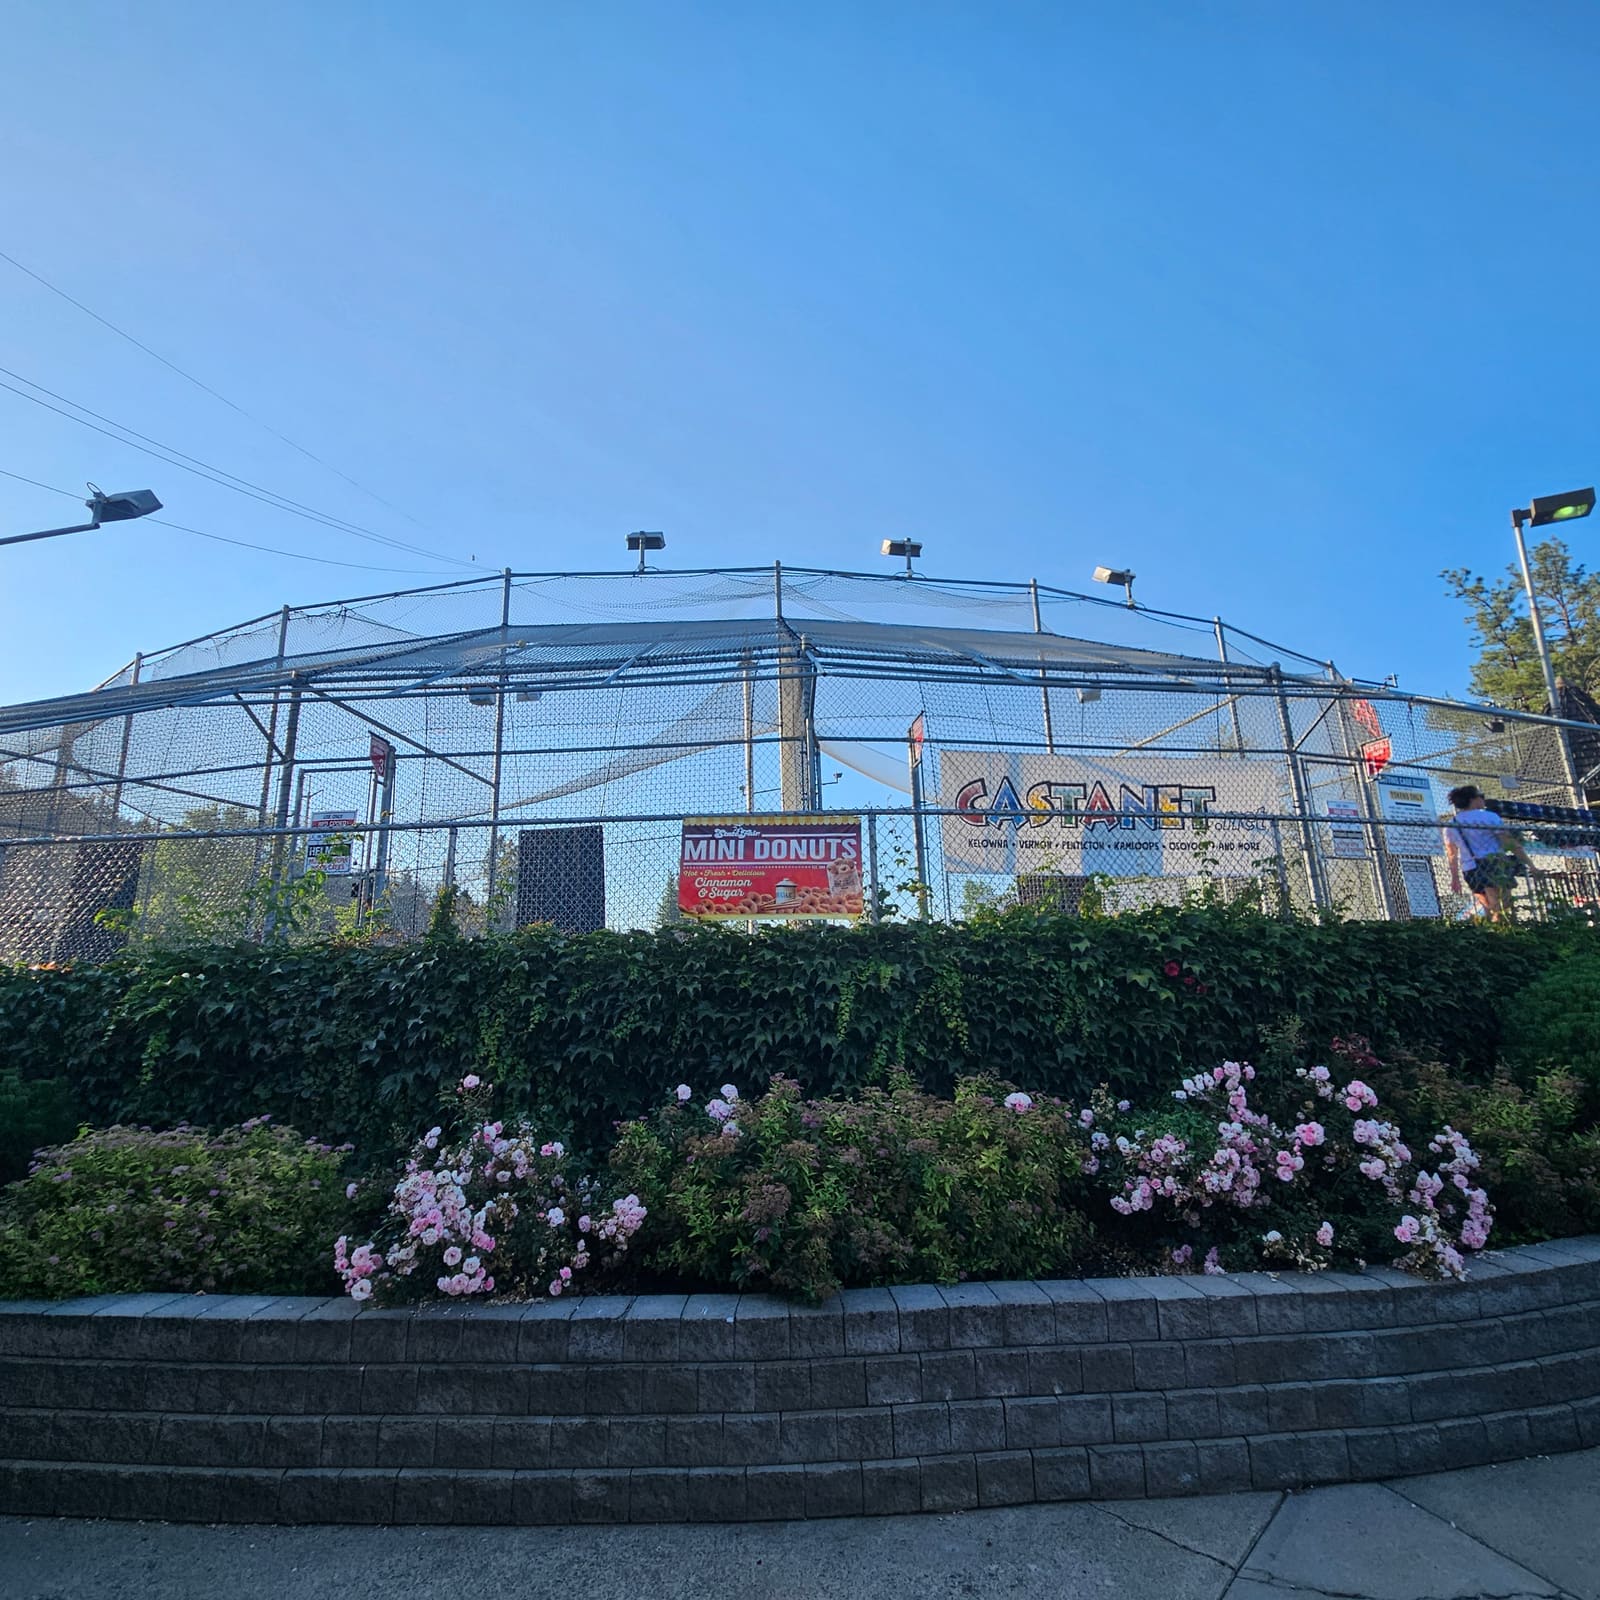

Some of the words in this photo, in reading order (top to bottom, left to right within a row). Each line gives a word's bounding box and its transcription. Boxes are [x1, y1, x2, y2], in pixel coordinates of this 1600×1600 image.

[955, 776, 1216, 832] CASTANET
[684, 840, 744, 860] MINI
[754, 839, 857, 860] DONUTS
[968, 838, 1009, 849] KELOWNA
[1061, 840, 1105, 850] PENTICTON
[1113, 841, 1160, 851] KAMLOOPS
[1218, 842, 1235, 851] AND
[1238, 842, 1261, 851] MORE
[695, 877, 752, 888] Cinnamon
[697, 888, 708, 898] &
[708, 887, 745, 900] Sugar
